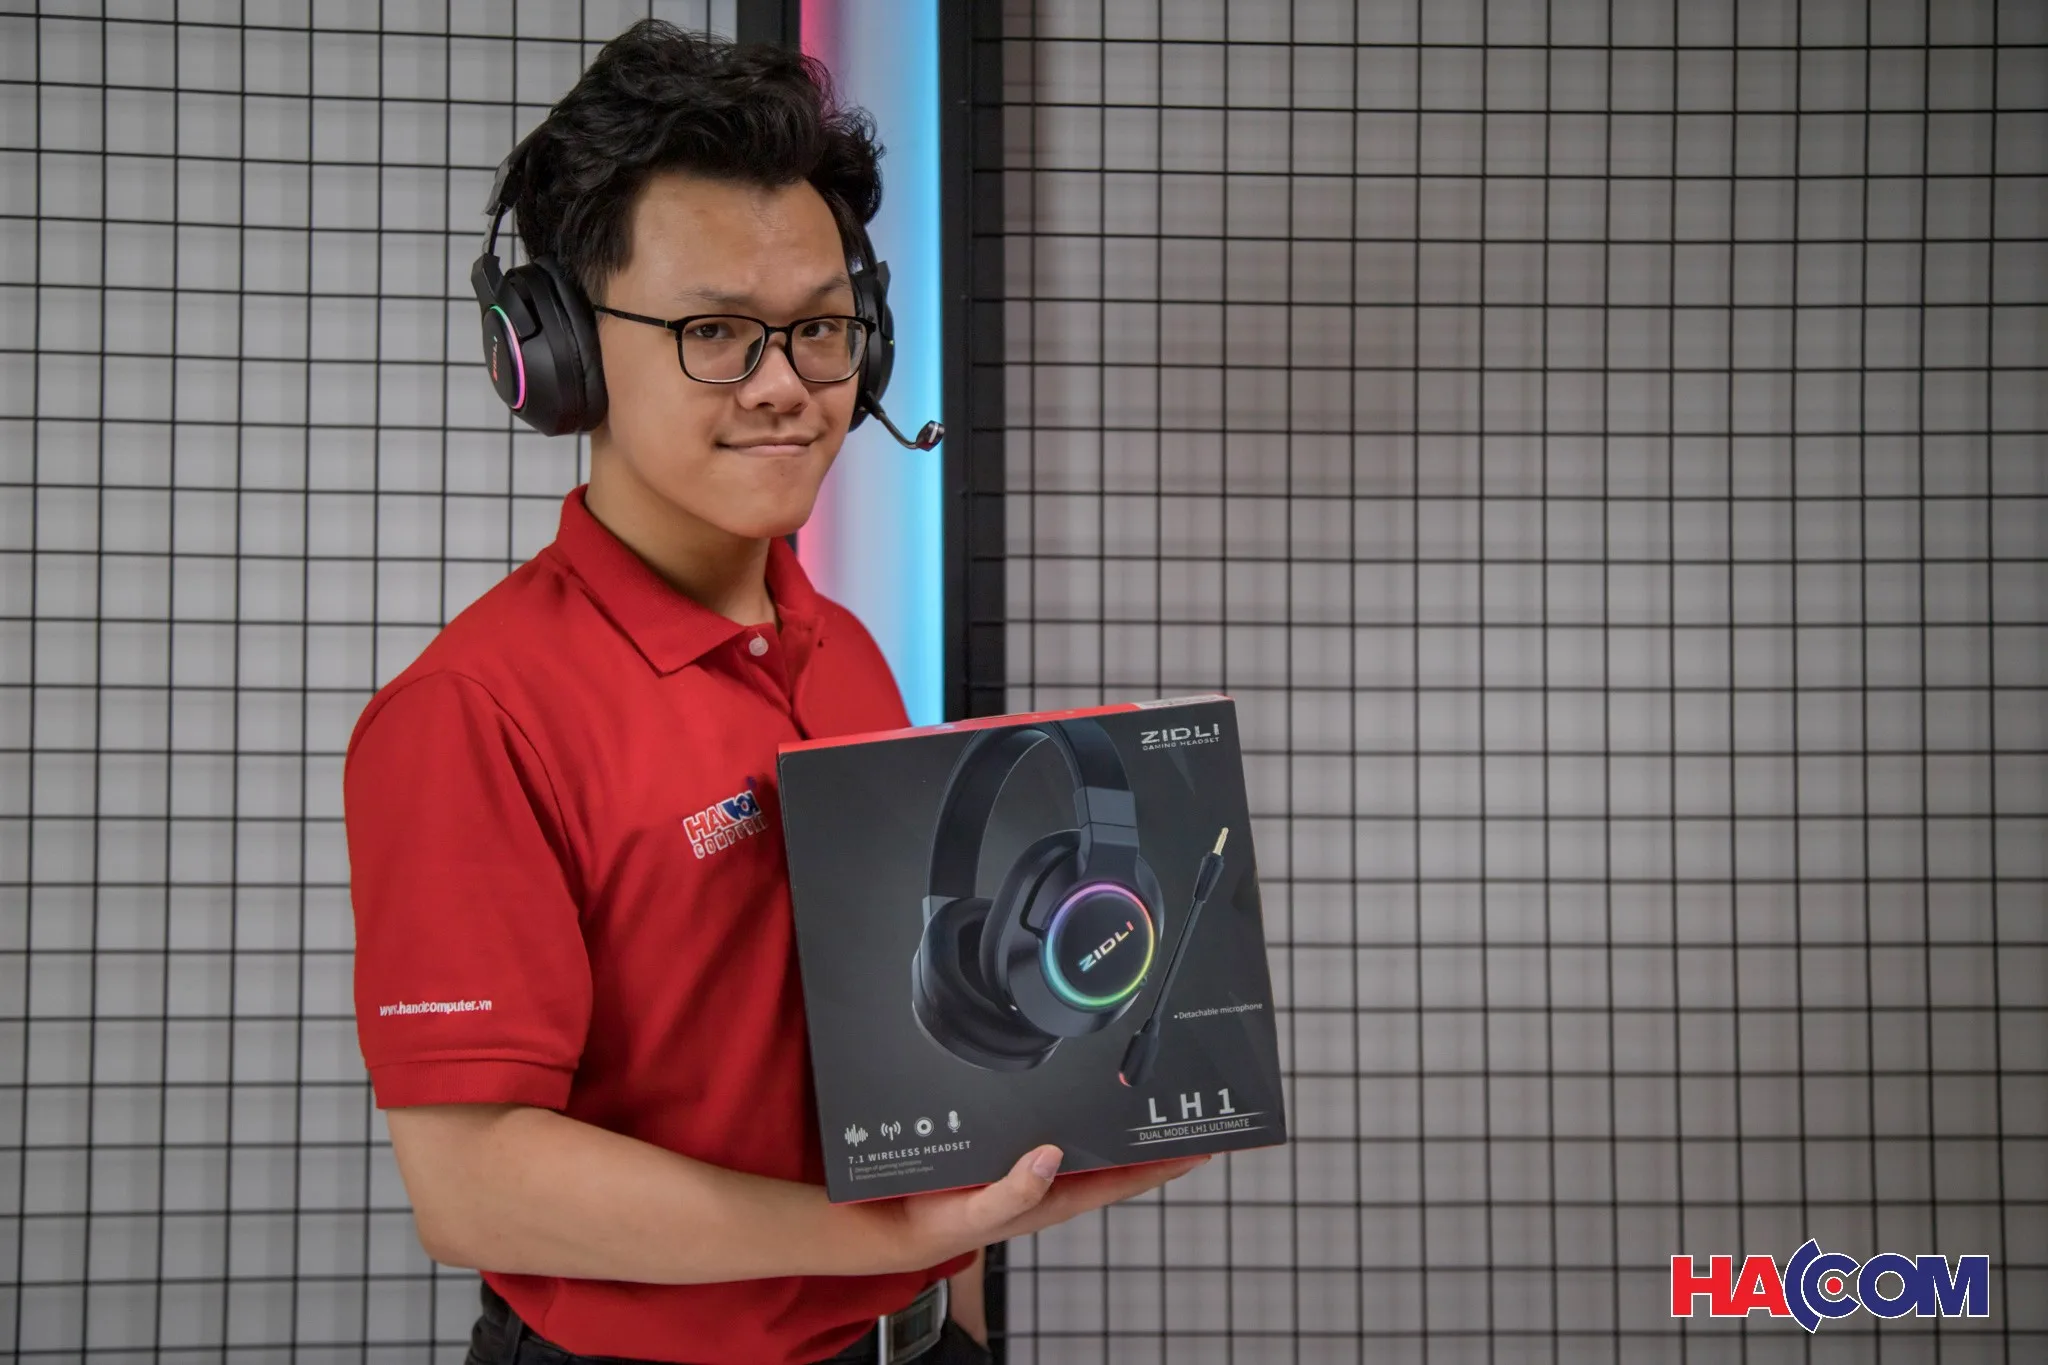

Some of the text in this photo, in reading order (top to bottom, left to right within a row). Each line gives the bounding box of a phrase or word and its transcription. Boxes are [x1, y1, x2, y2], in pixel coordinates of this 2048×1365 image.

[1140, 723, 1220, 744] ZIDLI
[1142, 737, 1220, 751] GAMING HEADSET
[1079, 920, 1134, 972] ZIDLI
[1178, 1003, 1263, 1019] Detachable microphone
[1140, 1118, 1250, 1141] DUAL MODE LH1 ULTIMATE
[848, 1140, 971, 1164] 7.1 WIRELESS HEADSET
